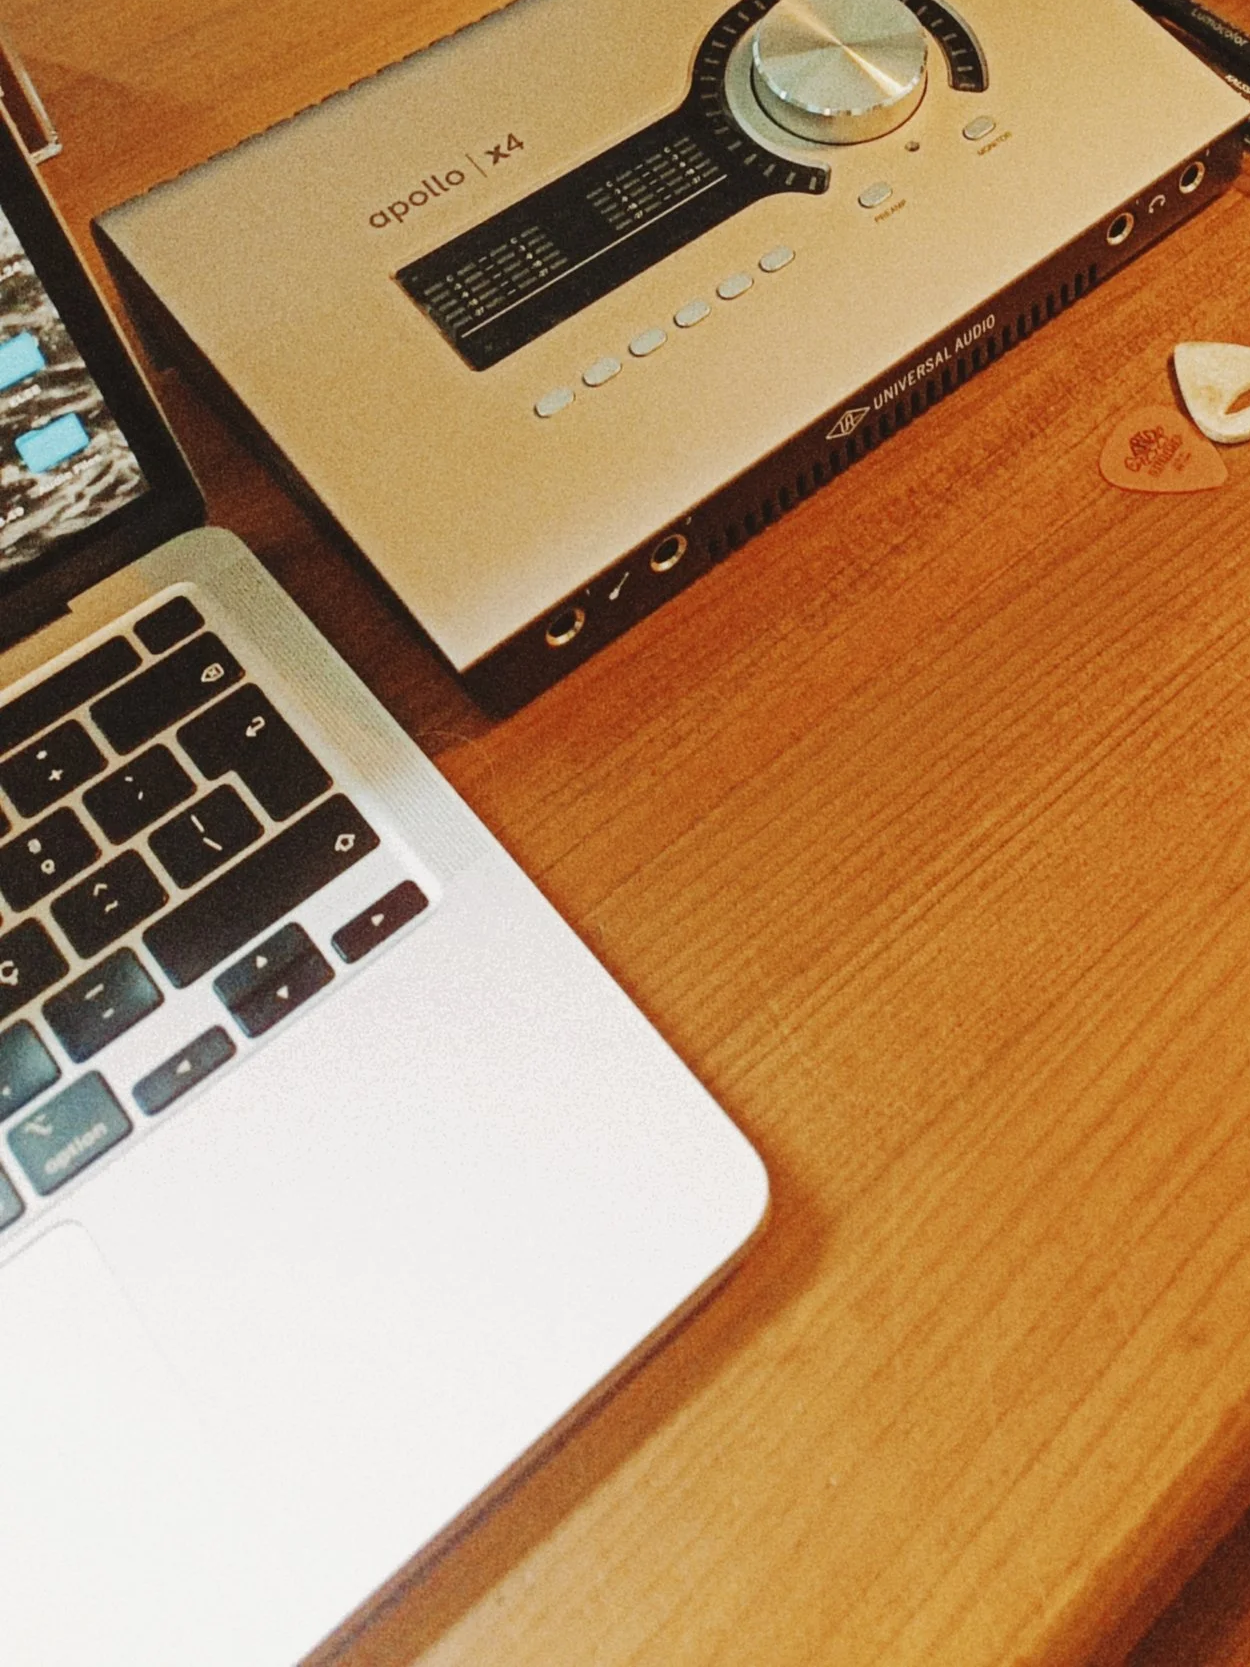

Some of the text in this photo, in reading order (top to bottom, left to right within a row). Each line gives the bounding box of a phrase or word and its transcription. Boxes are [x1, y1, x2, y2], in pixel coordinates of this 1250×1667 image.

[1191, 8, 1248, 47] Lumocolor
[369, 132, 525, 228] apollo x4
[874, 198, 907, 223] PREAMP
[872, 313, 996, 411] UNIVERSAL AUDIO
